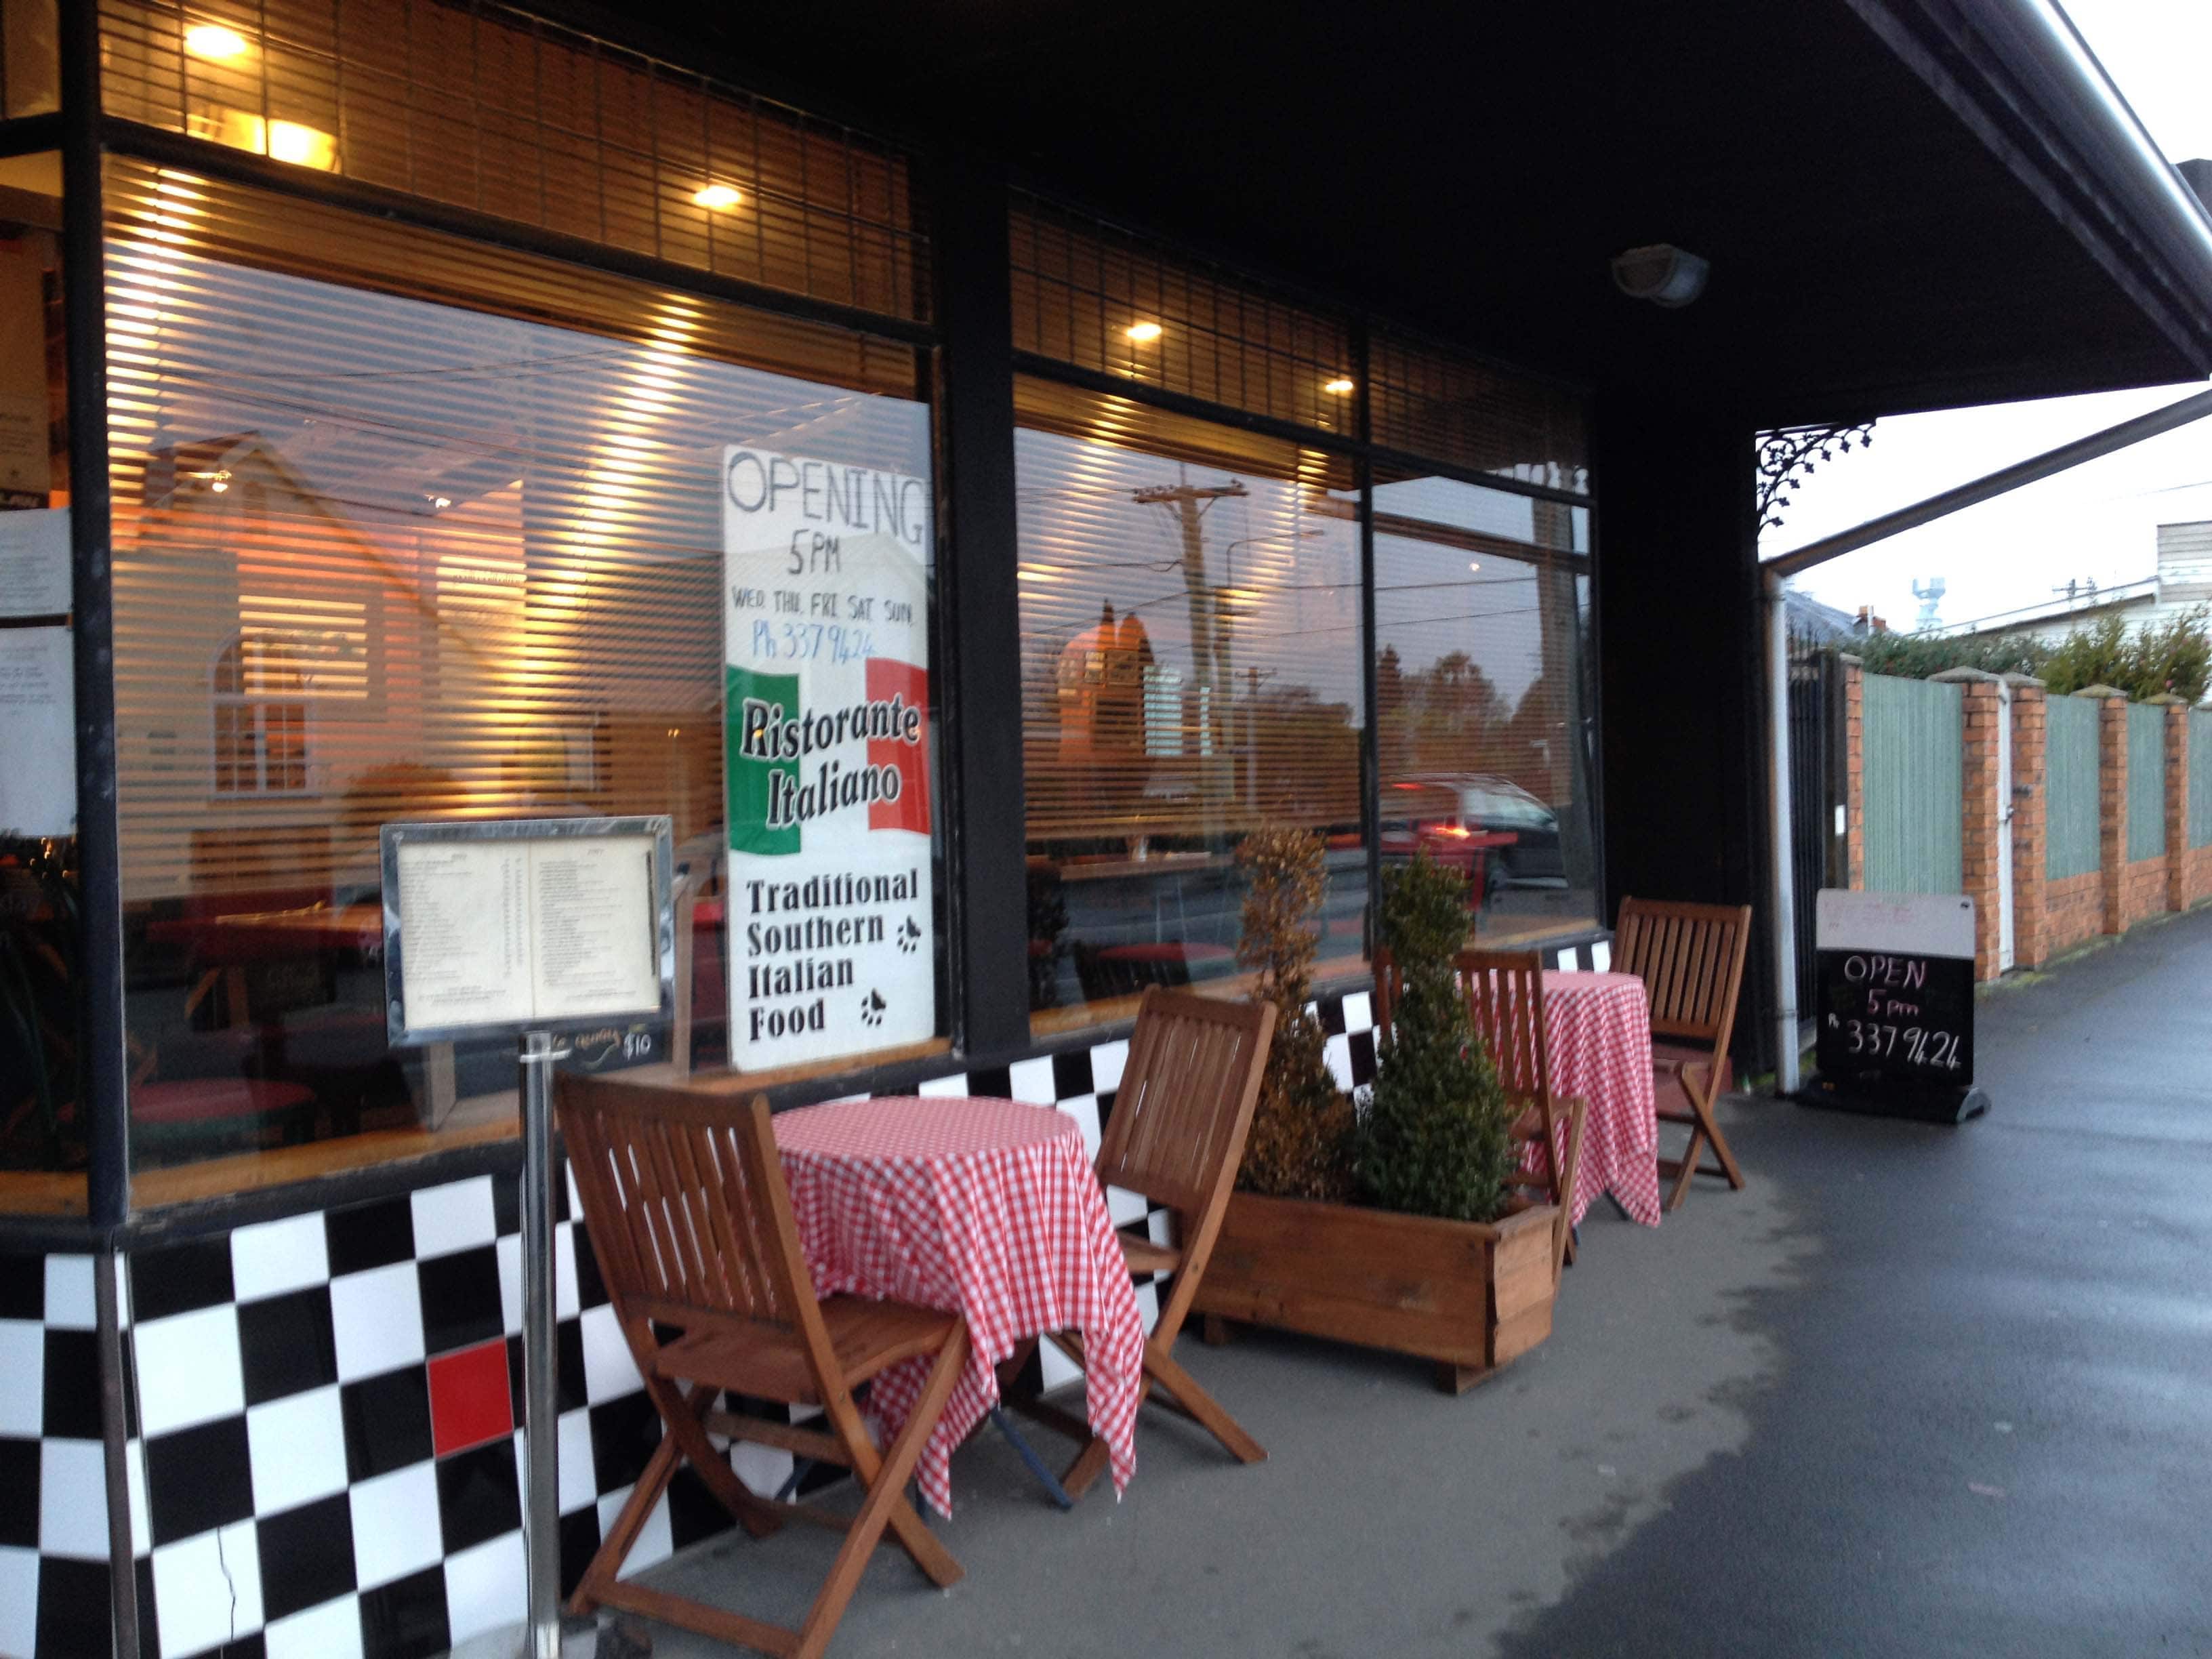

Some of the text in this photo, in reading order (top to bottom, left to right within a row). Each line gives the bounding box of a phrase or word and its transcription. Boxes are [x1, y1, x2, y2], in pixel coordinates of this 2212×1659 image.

[727, 451, 922, 545] OPENING
[787, 529, 841, 575] 5 PM
[752, 618, 776, 657] Ph
[740, 692, 921, 759] Ristorante
[766, 760, 902, 829] Italiano
[747, 867, 918, 913] Traditional
[747, 914, 884, 957] Southern
[748, 958, 854, 999] Italian
[1844, 956, 1927, 989] OPEN
[749, 998, 825, 1041] Food
[1868, 989, 1887, 1015] 5
